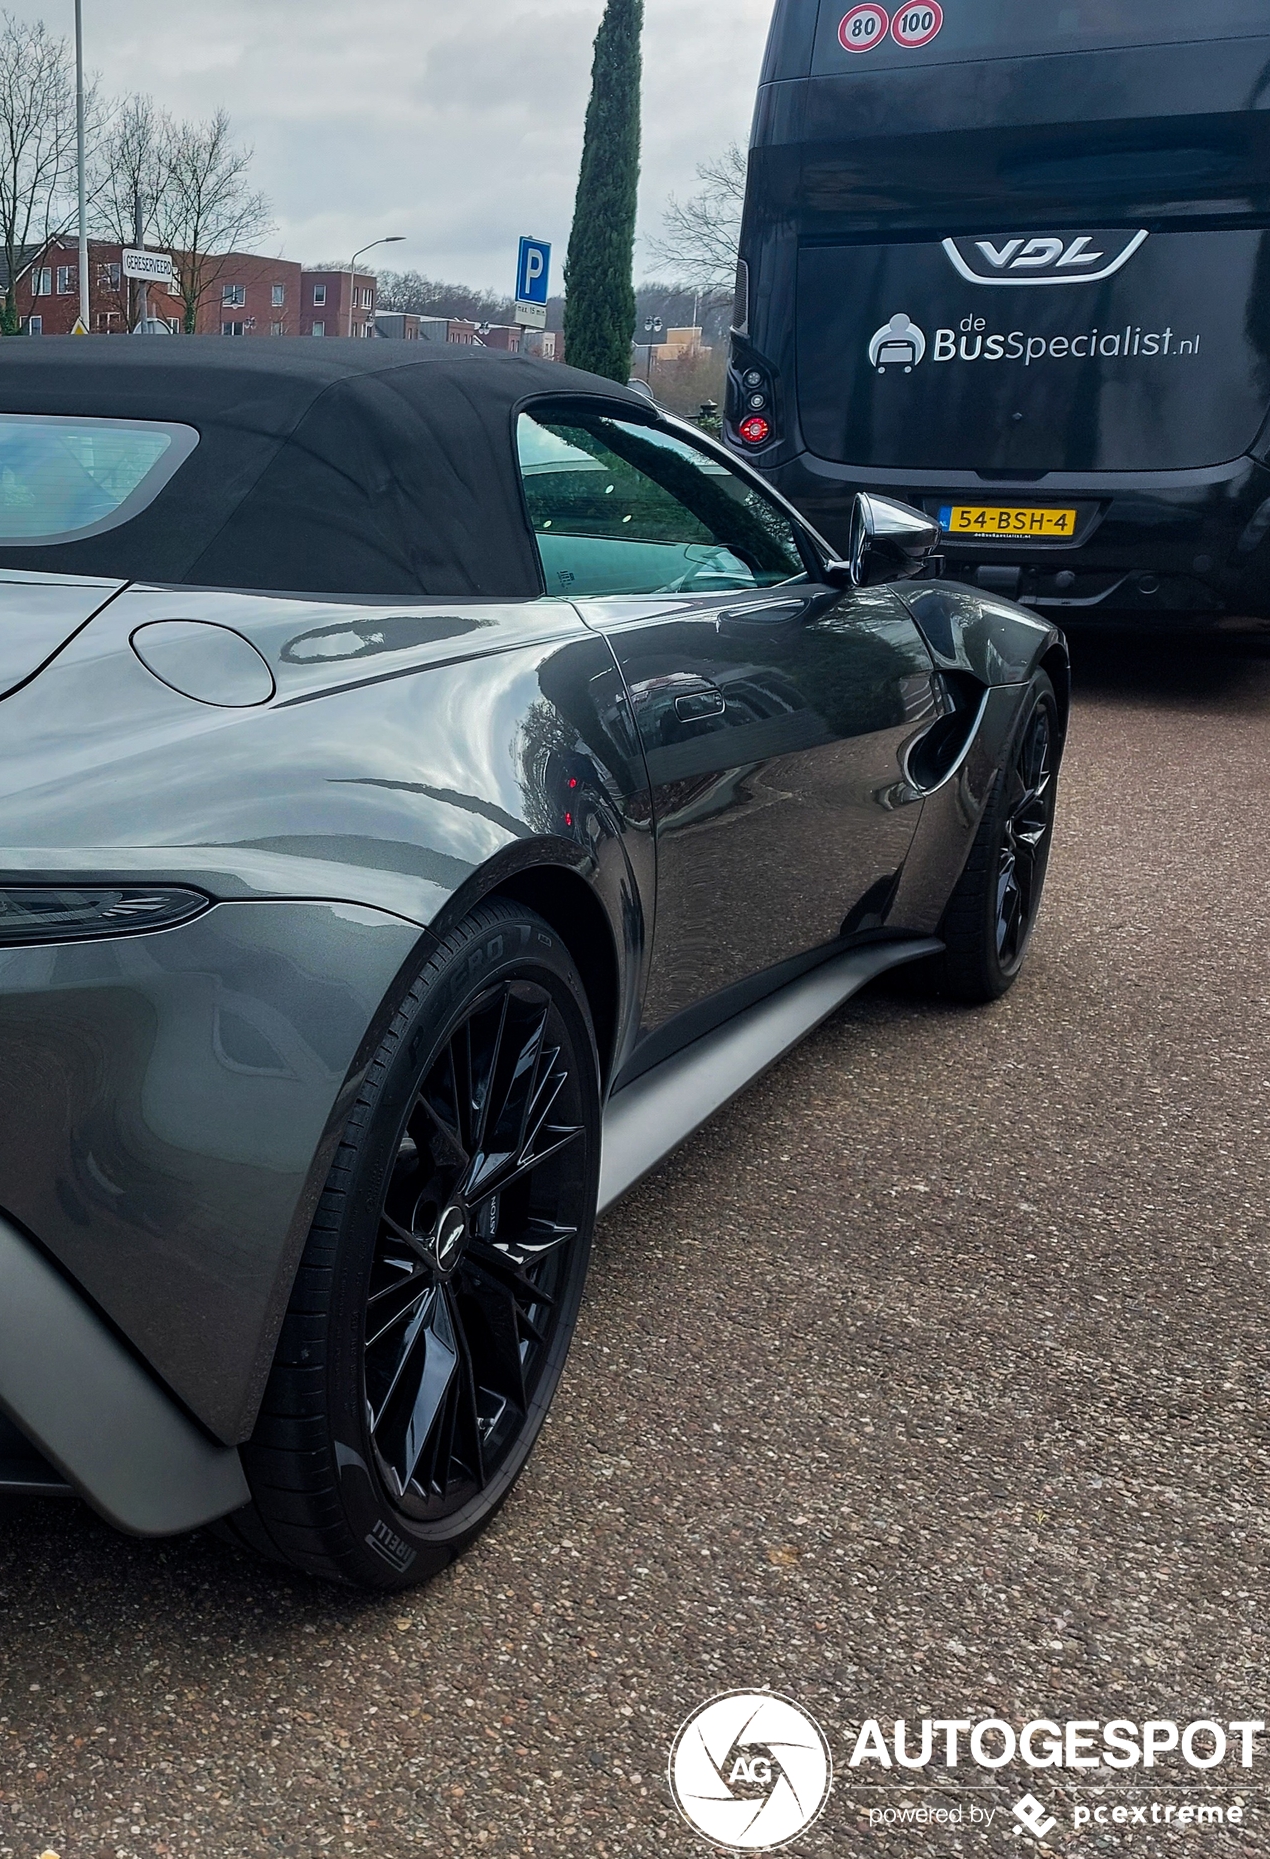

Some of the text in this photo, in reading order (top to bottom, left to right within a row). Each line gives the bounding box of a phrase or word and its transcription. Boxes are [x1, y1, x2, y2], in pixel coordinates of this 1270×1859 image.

[851, 17, 876, 38] 80
[901, 11, 934, 34] 100
[974, 236, 1105, 270] VDL
[524, 247, 544, 295] P
[959, 312, 987, 333] de
[958, 510, 1069, 532] 54-BSH-4
[364, 1519, 418, 1574] PIRELLI
